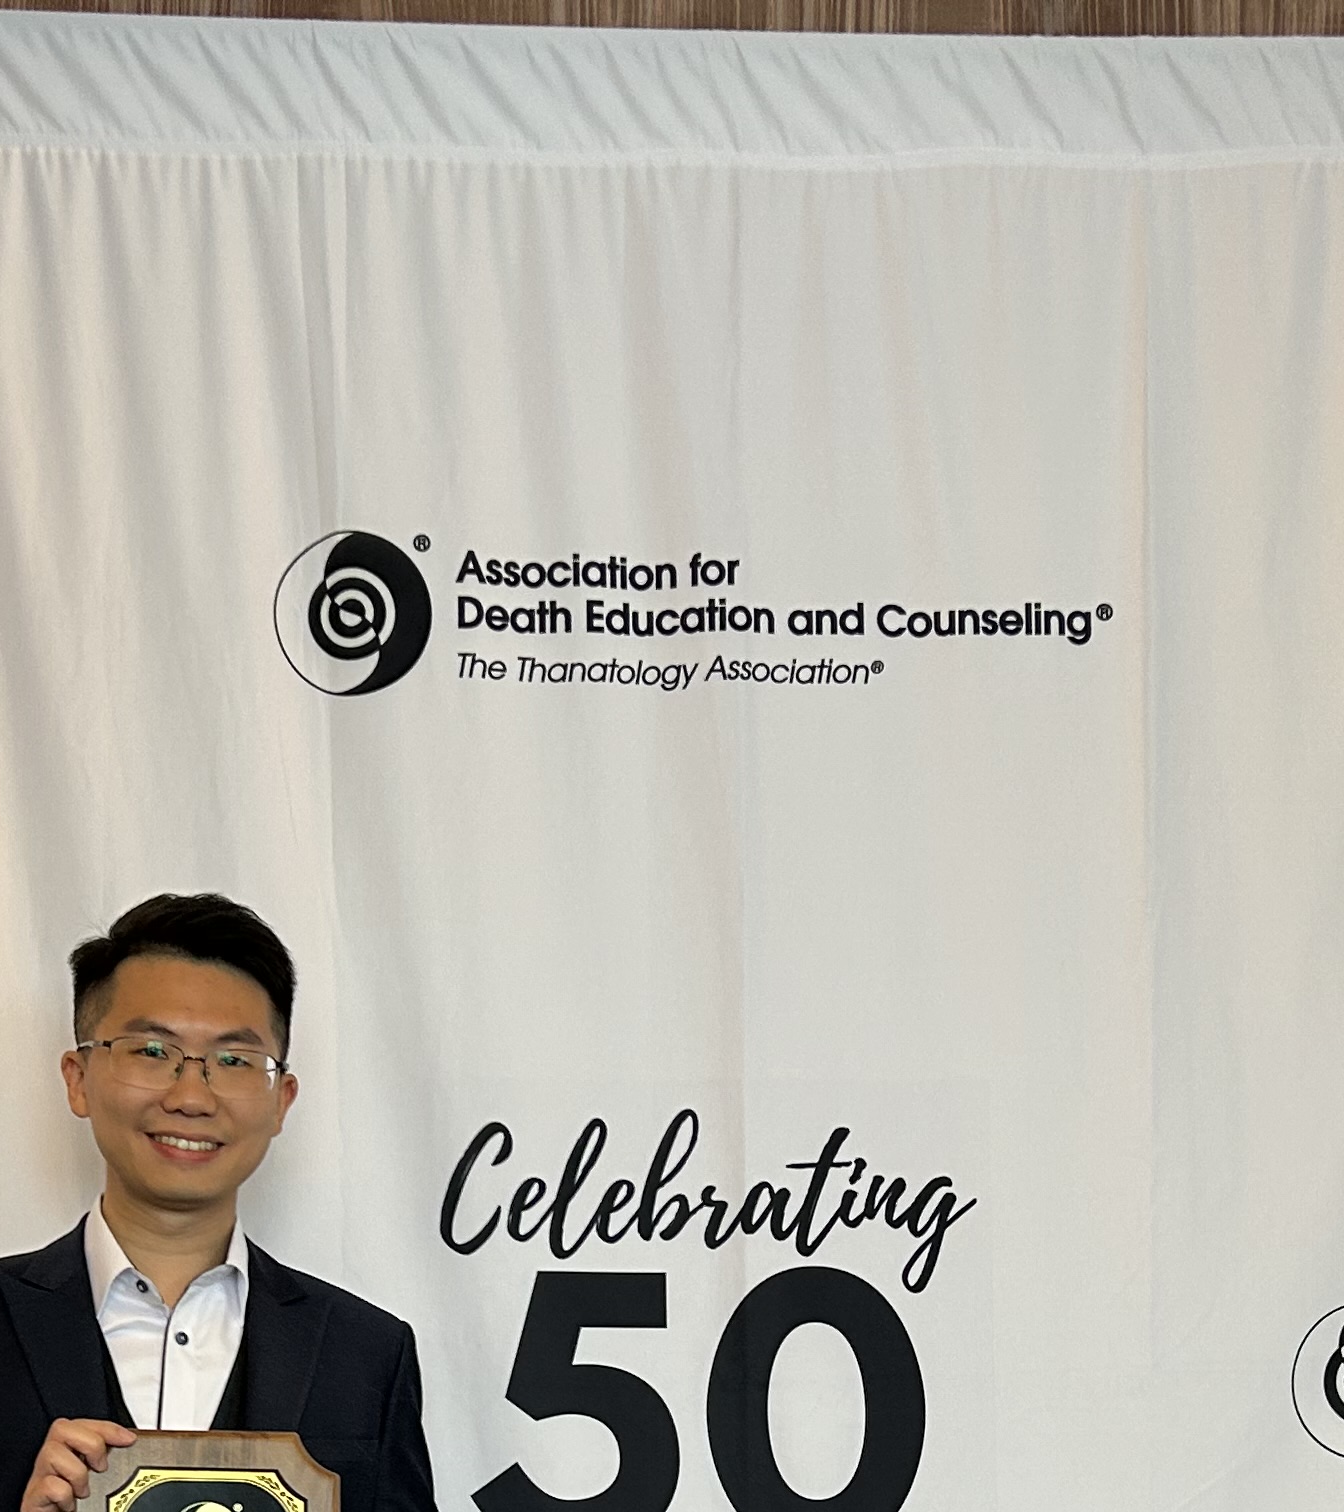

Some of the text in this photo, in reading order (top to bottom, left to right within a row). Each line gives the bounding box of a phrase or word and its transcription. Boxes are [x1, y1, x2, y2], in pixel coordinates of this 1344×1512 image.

[455, 550, 740, 591] Association for
[458, 596, 572, 634] Death
[586, 598, 775, 637] Education
[788, 602, 864, 636] and
[458, 652, 507, 680] The
[517, 656, 699, 691] Thanatology
[440, 1109, 977, 1293] Celebrating
